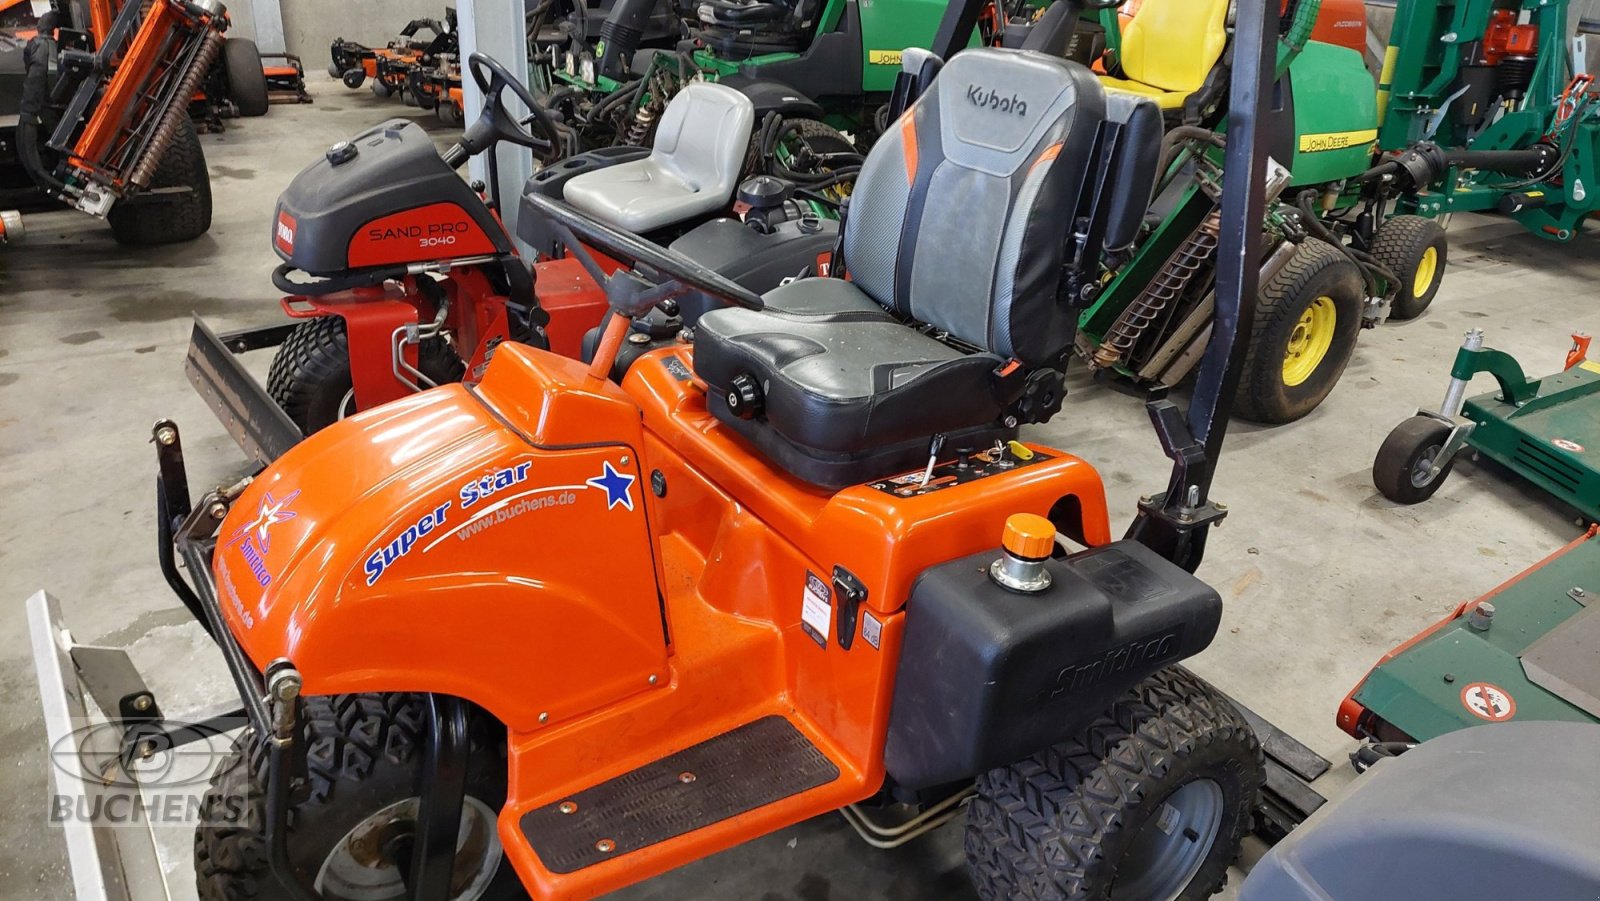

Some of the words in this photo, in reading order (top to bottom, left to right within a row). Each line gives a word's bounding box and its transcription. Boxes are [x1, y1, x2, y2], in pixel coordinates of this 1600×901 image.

[878, 52, 903, 63] JOHN
[966, 84, 1028, 117] Kubota
[1306, 137, 1327, 151] JOHN
[1327, 136, 1349, 149] DEERE
[369, 226, 422, 241] SAND
[428, 222, 469, 236] PRO
[419, 236, 456, 247] 3040
[364, 500, 452, 586] Super
[460, 460, 532, 509] Star
[457, 491, 576, 541] www.buchens.de
[240, 537, 272, 588] Smithco
[1051, 633, 1176, 698] Smithco
